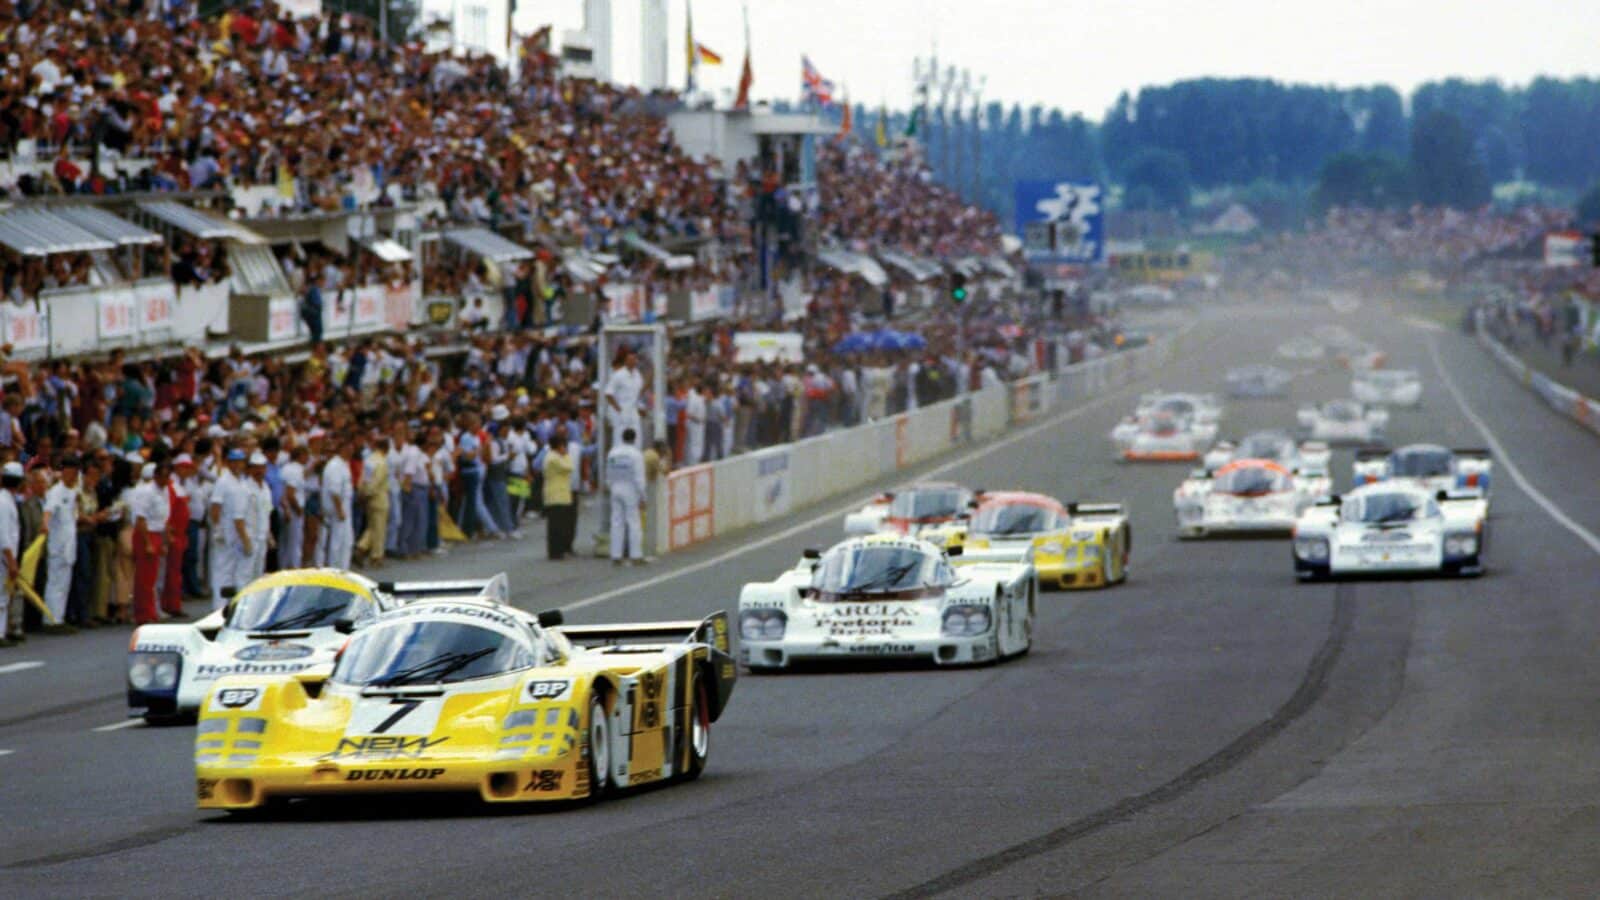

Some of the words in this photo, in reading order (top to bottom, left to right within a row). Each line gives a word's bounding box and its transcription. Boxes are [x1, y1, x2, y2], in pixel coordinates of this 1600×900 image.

[432, 607, 516, 628] RACING
[197, 663, 316, 675] Rothma
[532, 683, 567, 697] BP
[223, 691, 257, 703] BP
[369, 698, 425, 733] 7
[346, 768, 446, 780] DUNLOP
